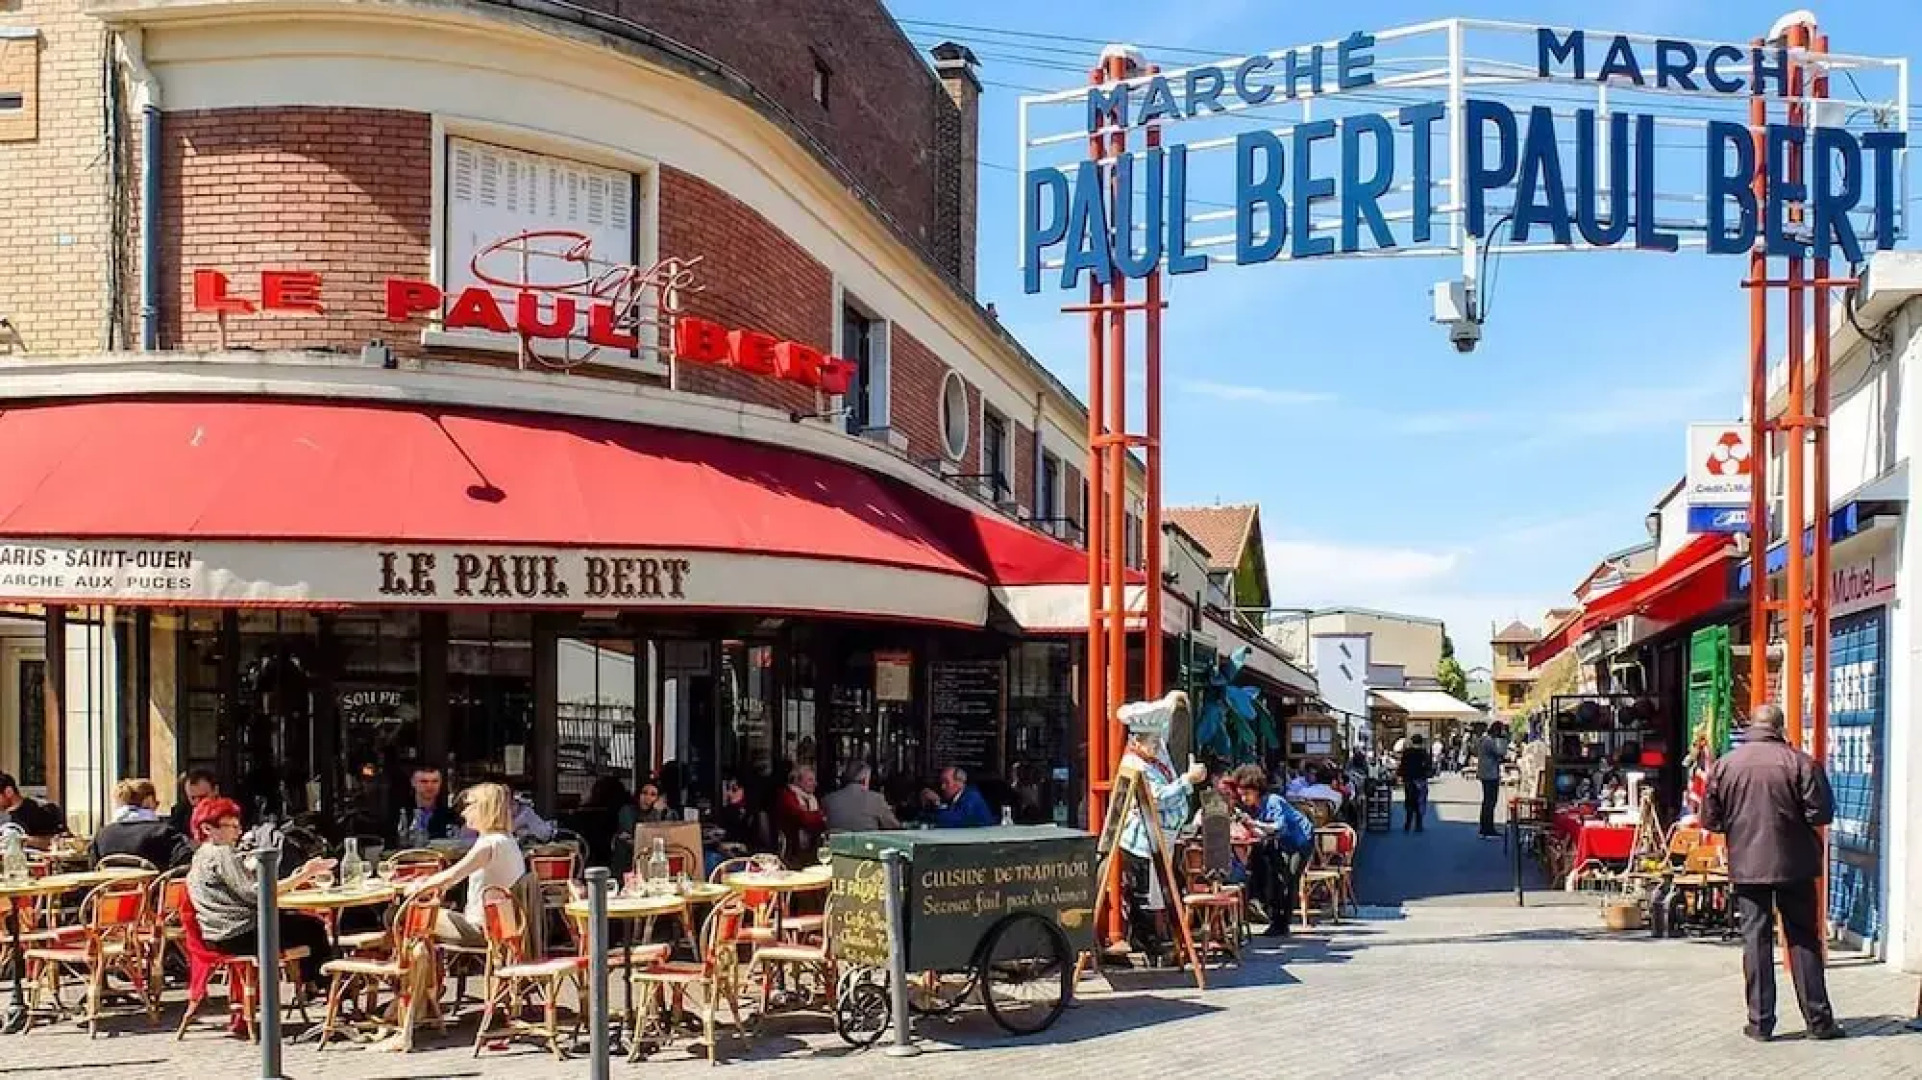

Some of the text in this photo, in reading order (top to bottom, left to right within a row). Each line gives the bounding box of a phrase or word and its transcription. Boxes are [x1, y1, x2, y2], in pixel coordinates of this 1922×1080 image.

[1086, 30, 1377, 134] MARCHÉ
[1537, 28, 1789, 97] MARCH
[1024, 101, 1445, 295] PAUL BERT
[1465, 99, 1907, 263] PAUL BERT
[471, 230, 705, 330] Café
[194, 268, 858, 394] LE PAUL BERT
[65, 549, 193, 568] SAINT-OUEN
[75, 575, 114, 588] AUX
[127, 576, 192, 589] PUCES
[378, 551, 691, 599] LE PAUL BERT
[1832, 554, 1875, 605] Mutuel
[342, 691, 401, 710] SOUPE
